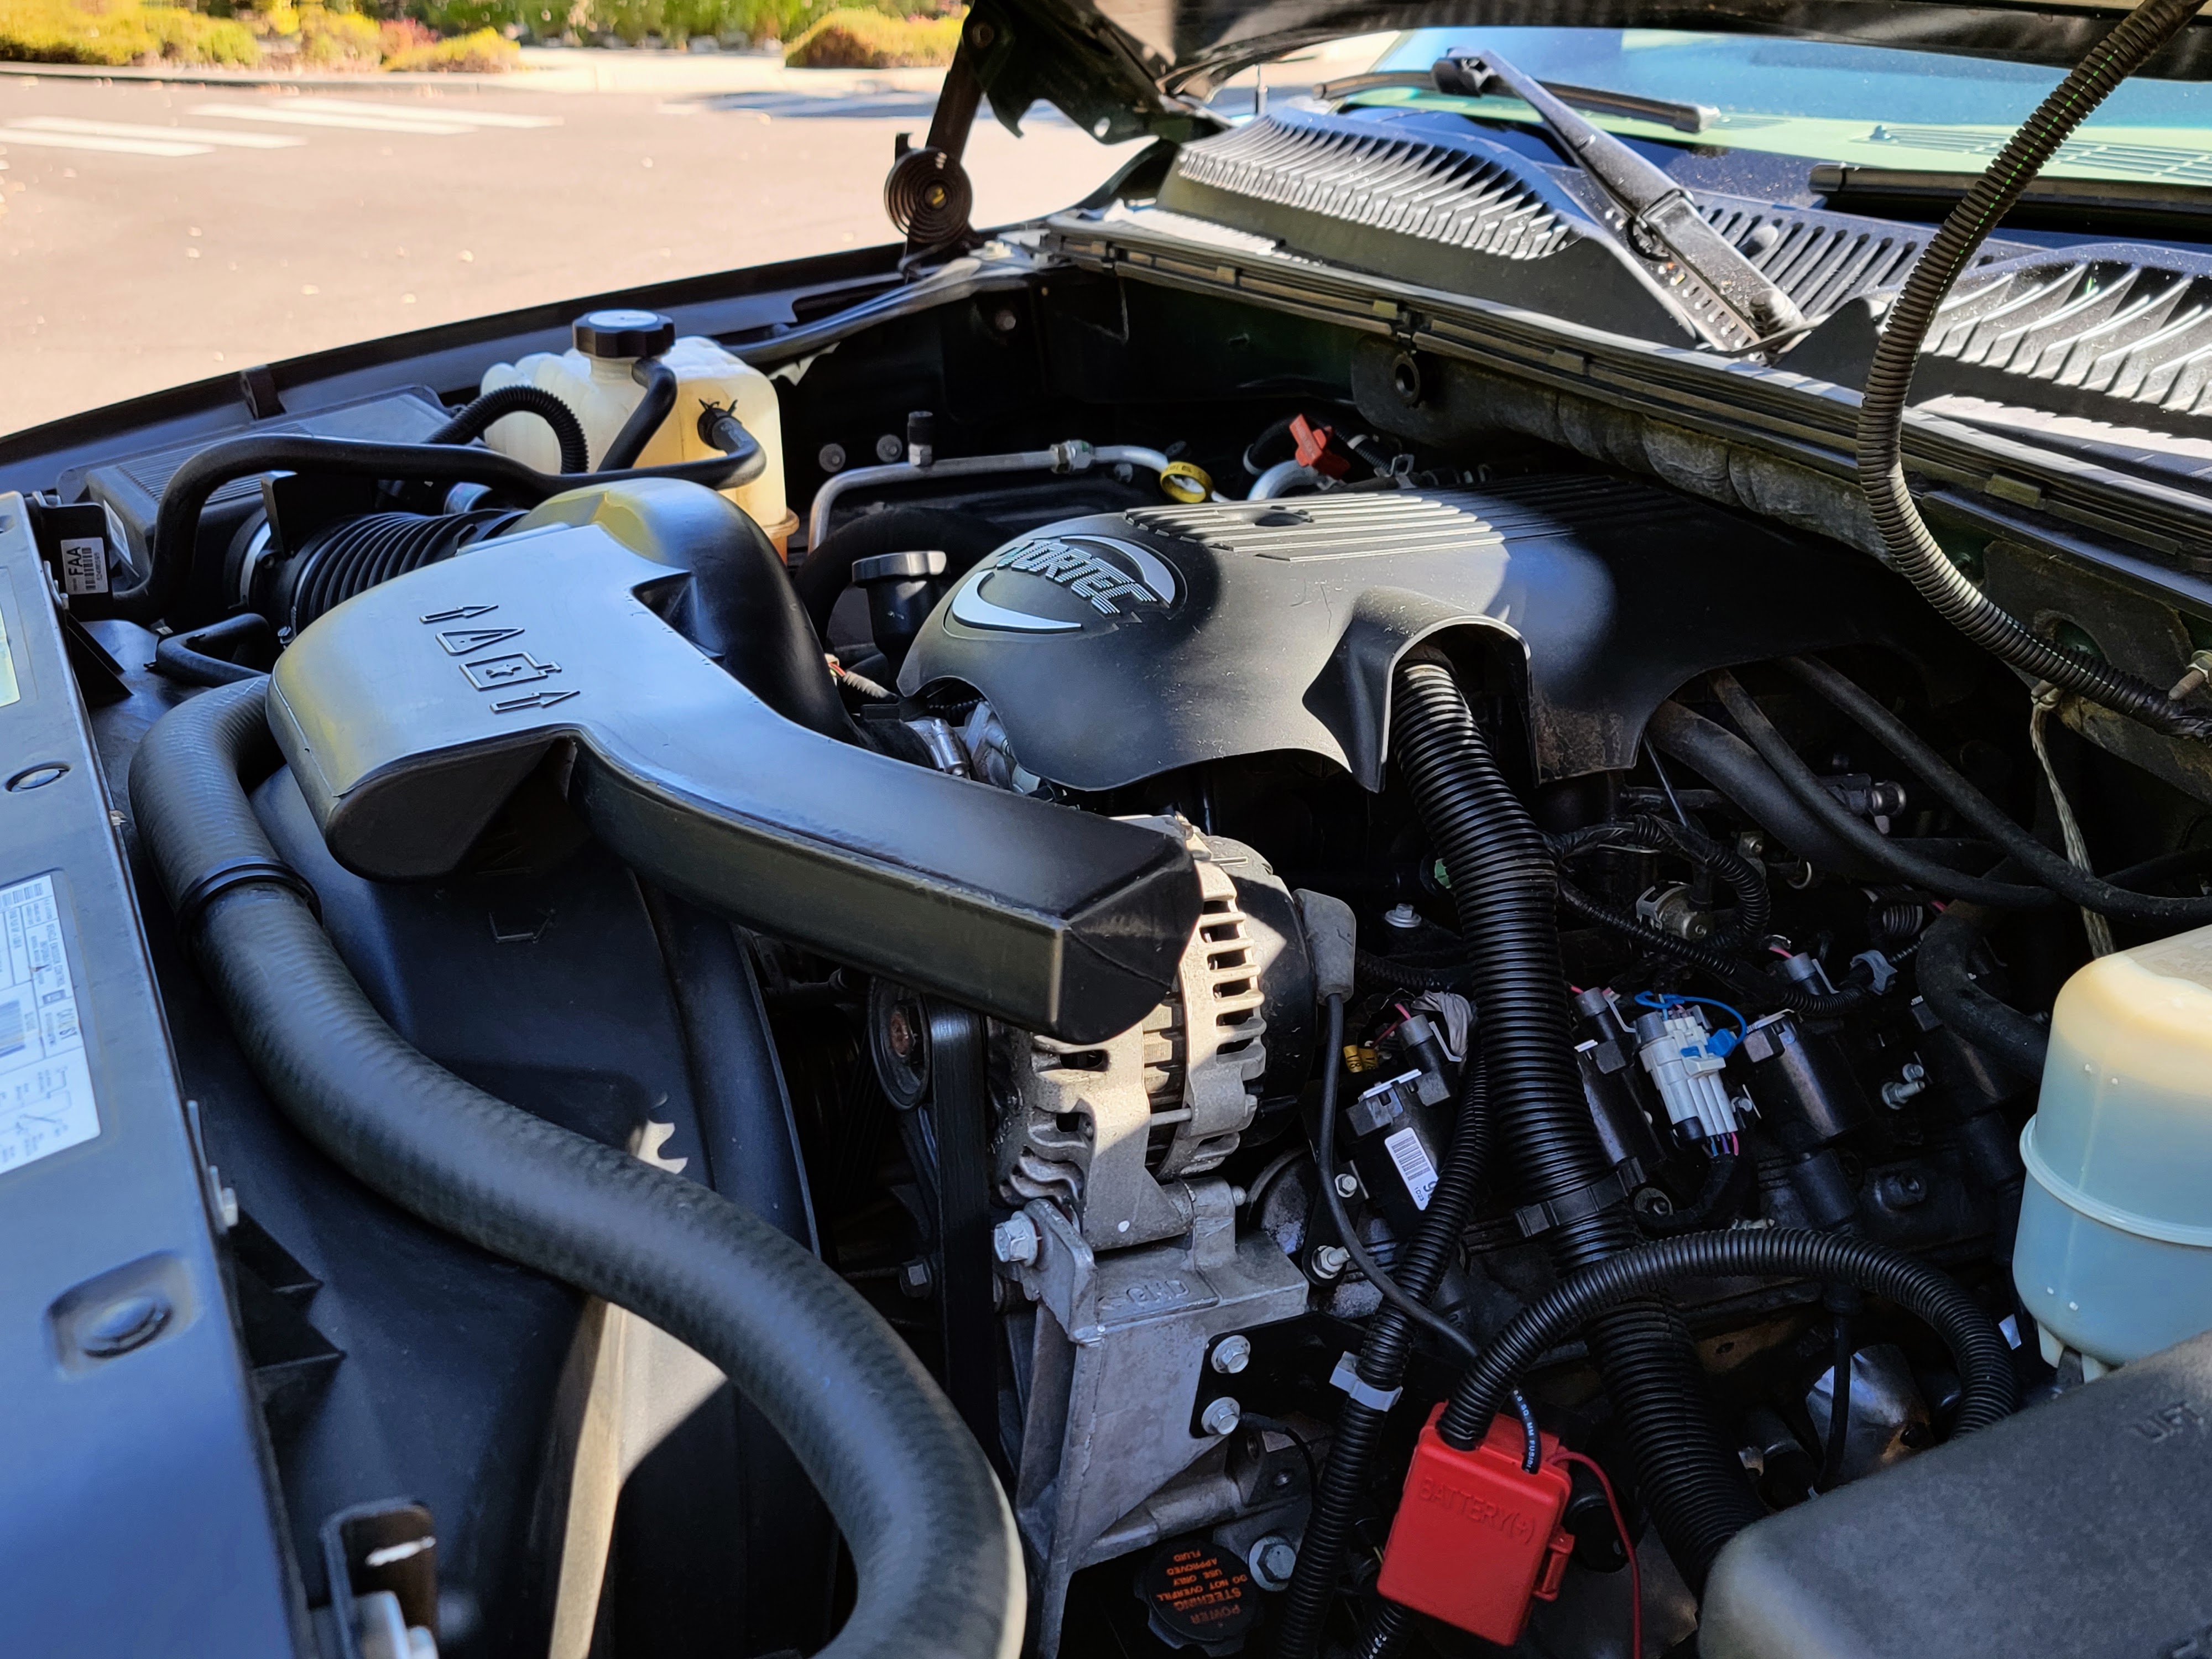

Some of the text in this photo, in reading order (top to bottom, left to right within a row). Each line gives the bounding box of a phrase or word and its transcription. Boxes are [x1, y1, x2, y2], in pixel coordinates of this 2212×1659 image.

[66, 546, 84, 576] FAA
[1526, 1422, 1535, 1436] MM
[1173, 1550, 1201, 1562] FLUID
[1166, 1557, 1217, 1576] APPROVED
[1173, 1568, 1223, 1586] USE ONLY
[1156, 1574, 1248, 1601] DO NOT OVERFILL
[1173, 1587, 1241, 1611] STEERING
[1191, 1604, 1241, 1624] POWER
